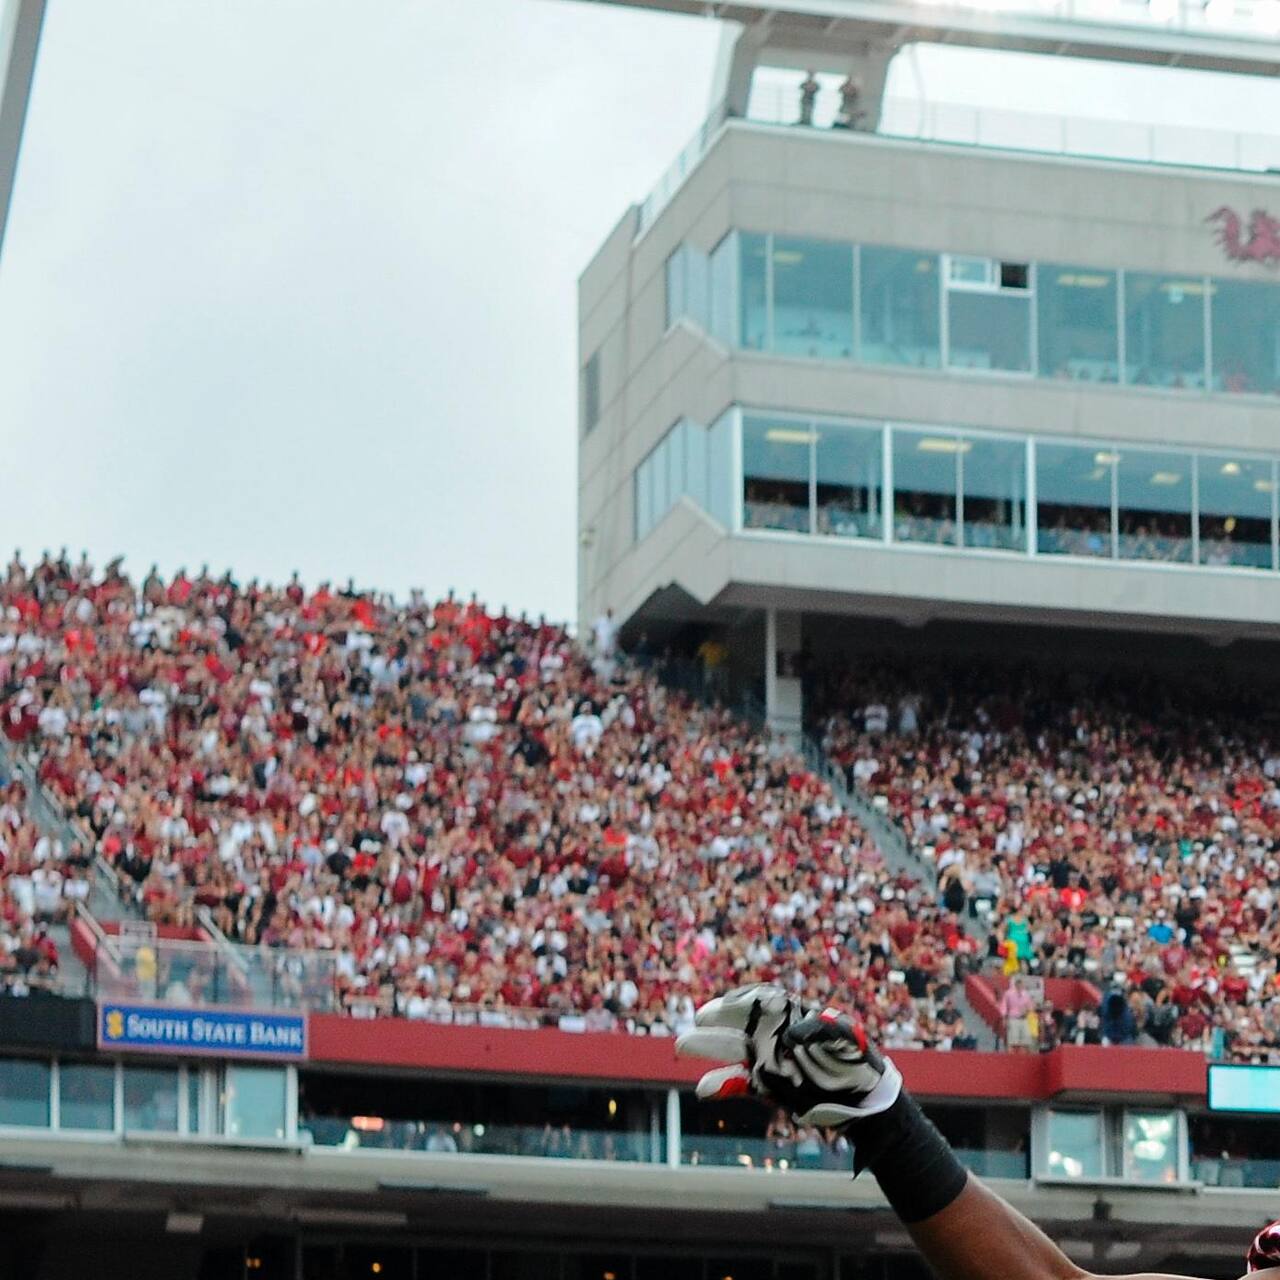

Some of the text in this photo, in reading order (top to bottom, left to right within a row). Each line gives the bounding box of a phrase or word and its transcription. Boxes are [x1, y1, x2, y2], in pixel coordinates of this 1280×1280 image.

[127, 1014, 301, 1047] SOUTH STATE BANK
